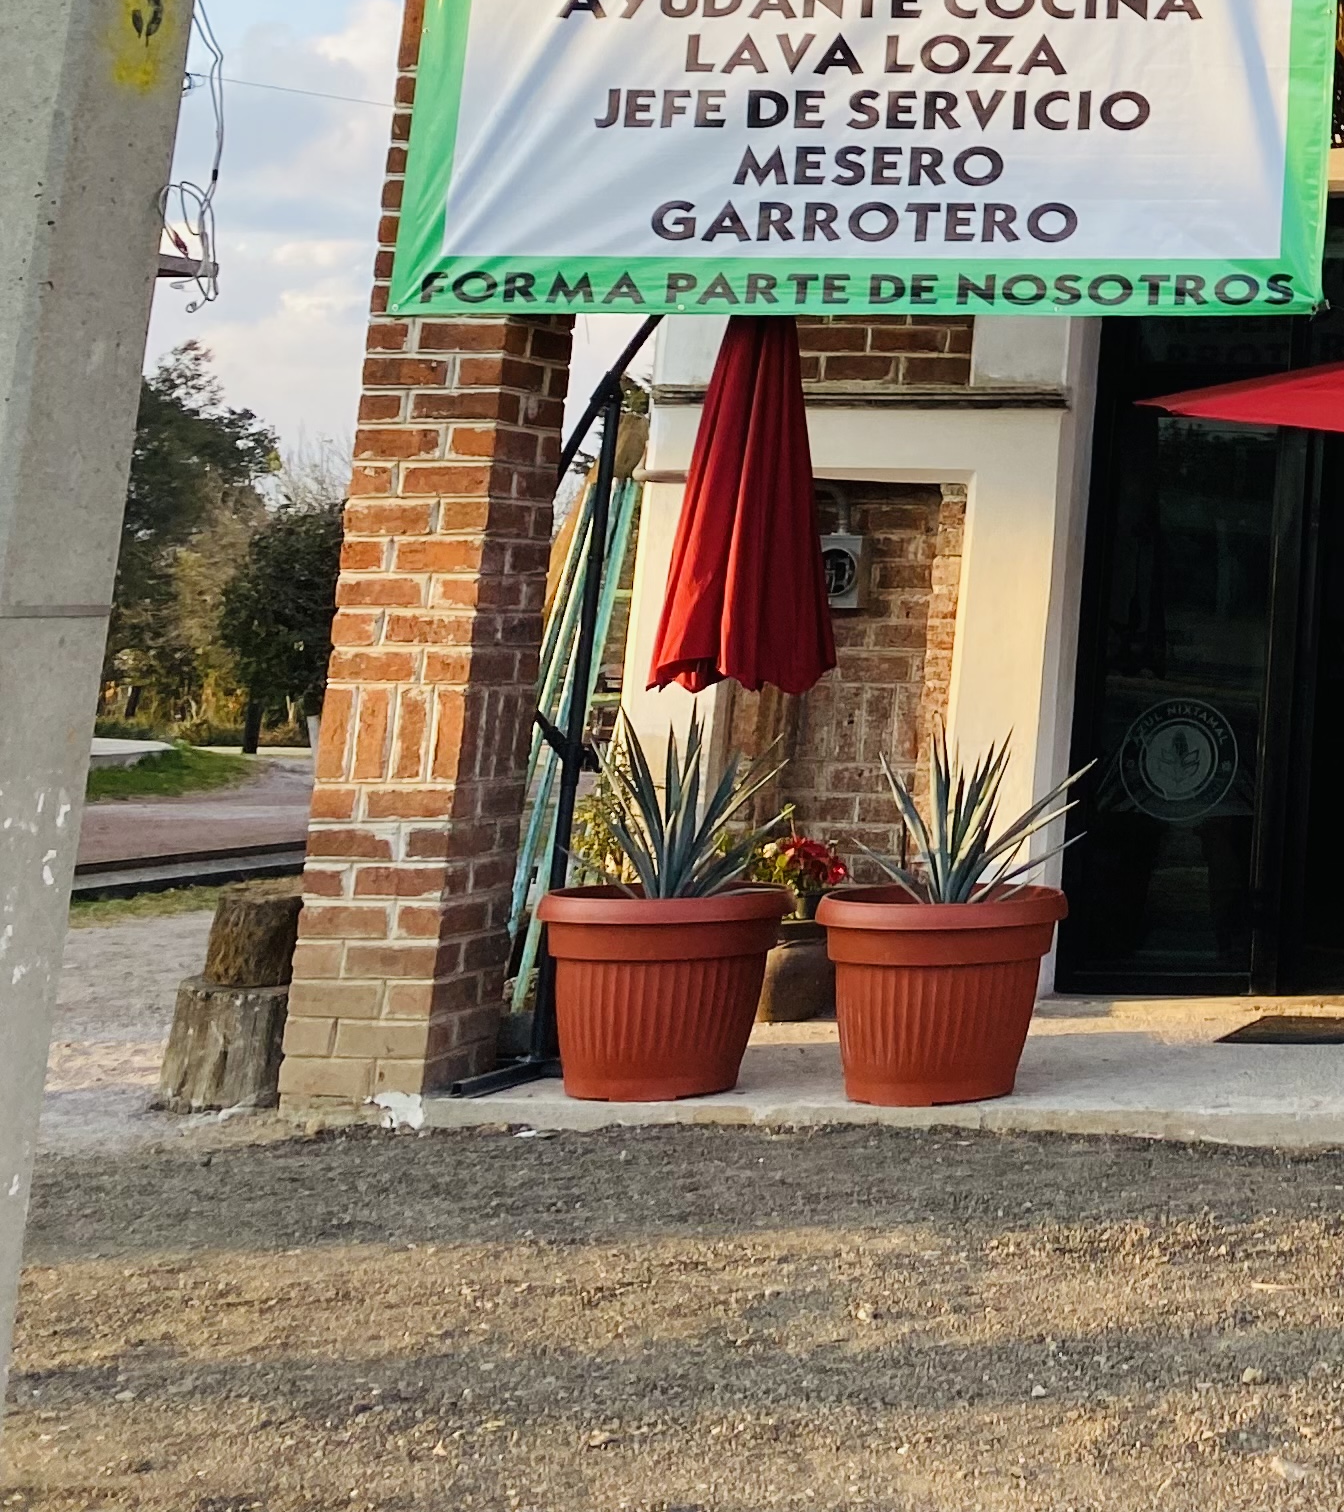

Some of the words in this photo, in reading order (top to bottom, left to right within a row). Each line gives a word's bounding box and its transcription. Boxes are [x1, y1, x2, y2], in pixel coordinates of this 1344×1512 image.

[684, 33, 864, 75] LAVA
[884, 34, 1068, 75] LOZA
[593, 89, 727, 129] JEFE
[746, 90, 826, 129] DE
[845, 89, 1151, 132] SERVICIO
[732, 145, 1004, 187] MESERO
[650, 200, 1079, 244] GARROTERO
[420, 271, 646, 304] FORMA
[664, 272, 853, 305] PARTE
[868, 273, 939, 305] DE
[957, 272, 1296, 307] NOSOTROS
